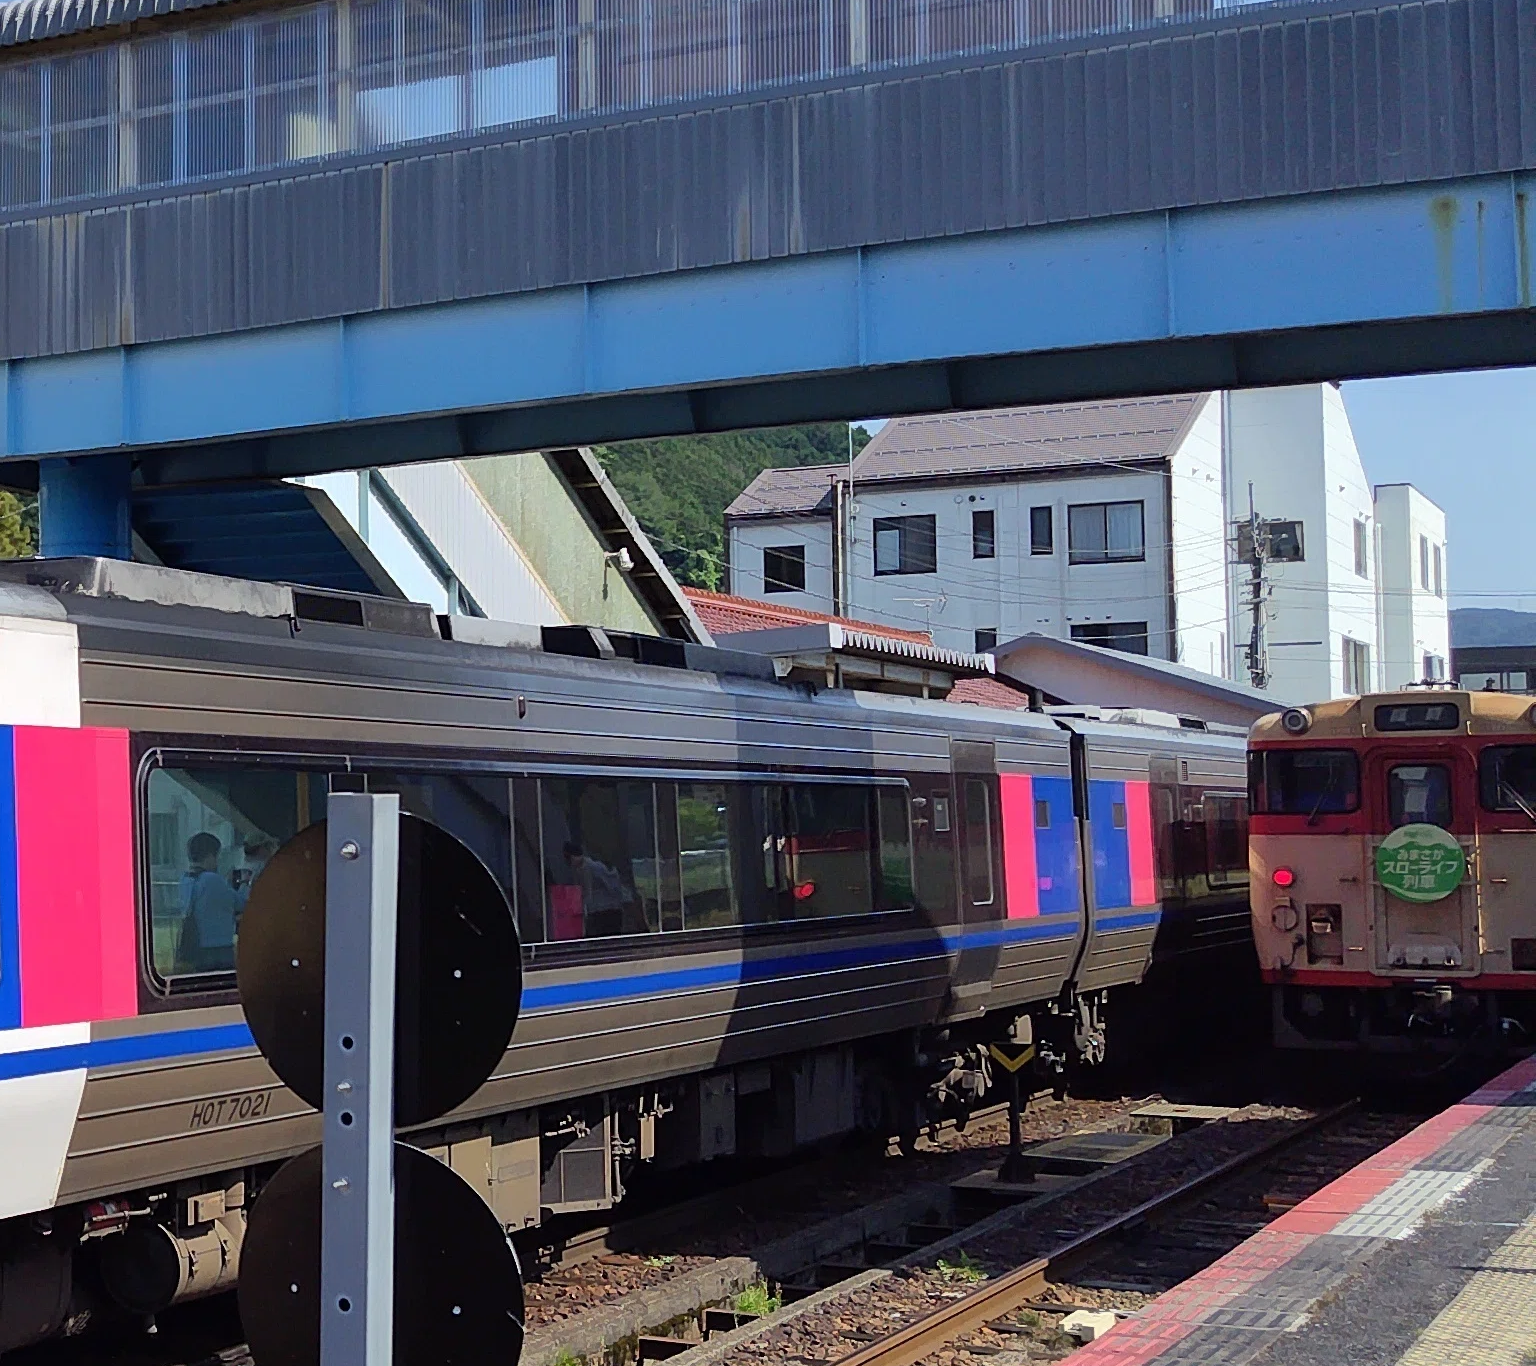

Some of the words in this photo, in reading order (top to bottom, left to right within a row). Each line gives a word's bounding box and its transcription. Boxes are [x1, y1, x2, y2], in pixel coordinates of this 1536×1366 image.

[1383, 860, 1458, 875] スローライフ
[1402, 874, 1436, 890] 列車
